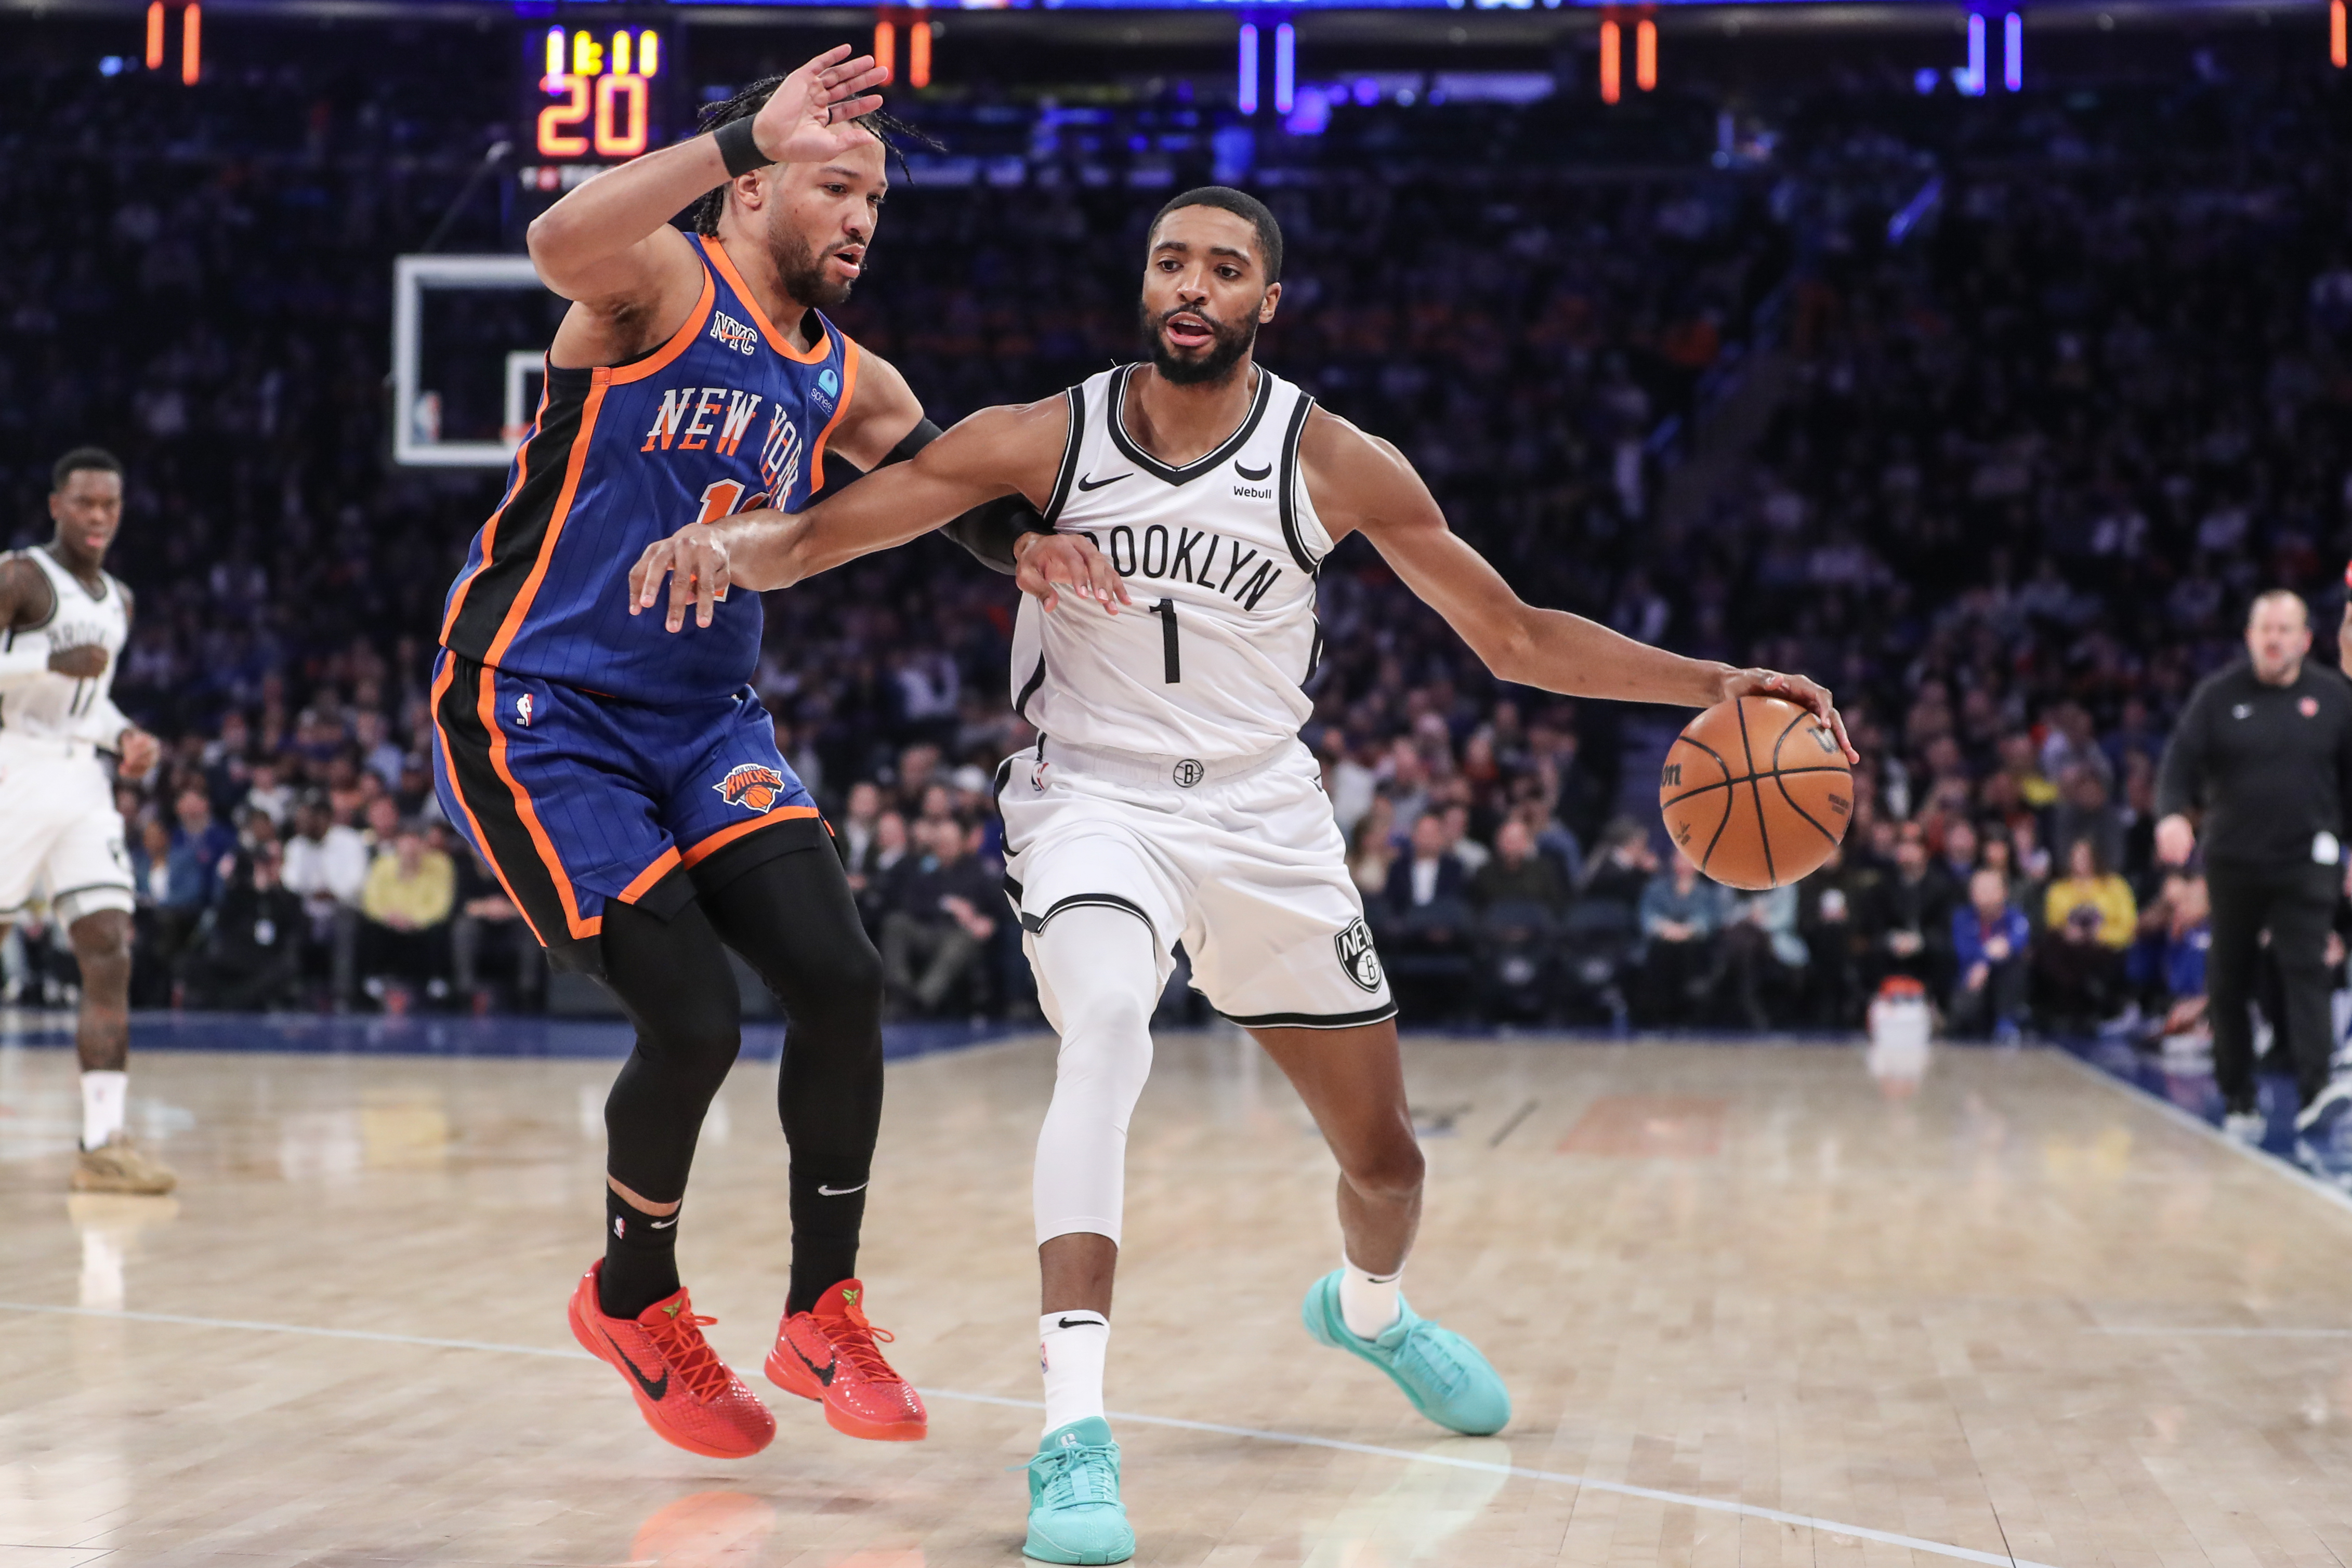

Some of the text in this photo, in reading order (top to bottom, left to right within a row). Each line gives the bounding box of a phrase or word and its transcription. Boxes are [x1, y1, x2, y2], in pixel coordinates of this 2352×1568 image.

[537, 73, 649, 155] 20
[710, 310, 758, 355] NYC
[811, 388, 833, 413] sphere
[641, 387, 802, 512] NEW YORK
[696, 478, 770, 524] 1
[1233, 485, 1272, 499] Webull
[1083, 524, 1282, 612] OOKLYN
[1149, 598, 1180, 684] 1
[726, 767, 782, 801] KNICKS
[1184, 764, 1193, 784] B
[1365, 954, 1376, 981] B
